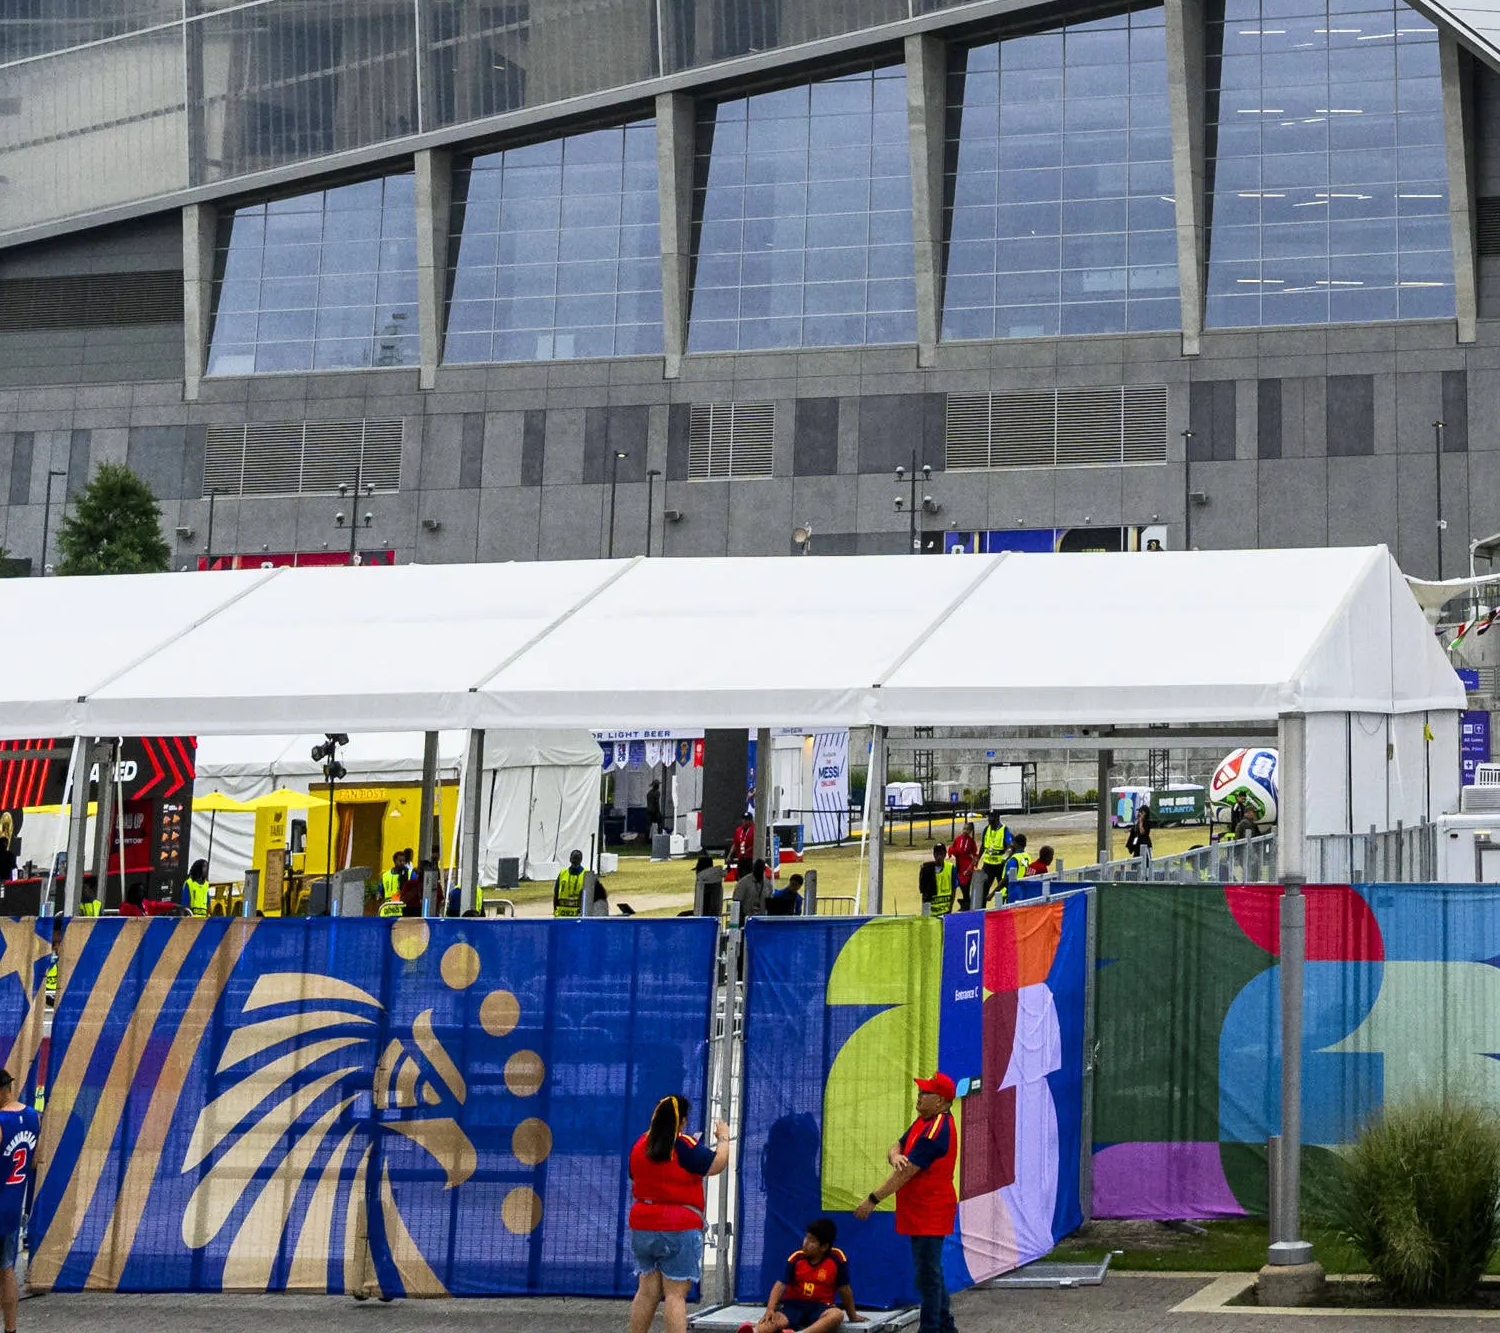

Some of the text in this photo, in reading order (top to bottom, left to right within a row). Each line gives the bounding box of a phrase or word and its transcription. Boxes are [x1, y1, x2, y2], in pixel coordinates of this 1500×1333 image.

[819, 766, 839, 779] MESSI
[1160, 806, 1195, 814] ATLANTA
[955, 986, 979, 1001] Entrance C
[6, 1148, 27, 1184] 2
[803, 1282, 815, 1297] 19
